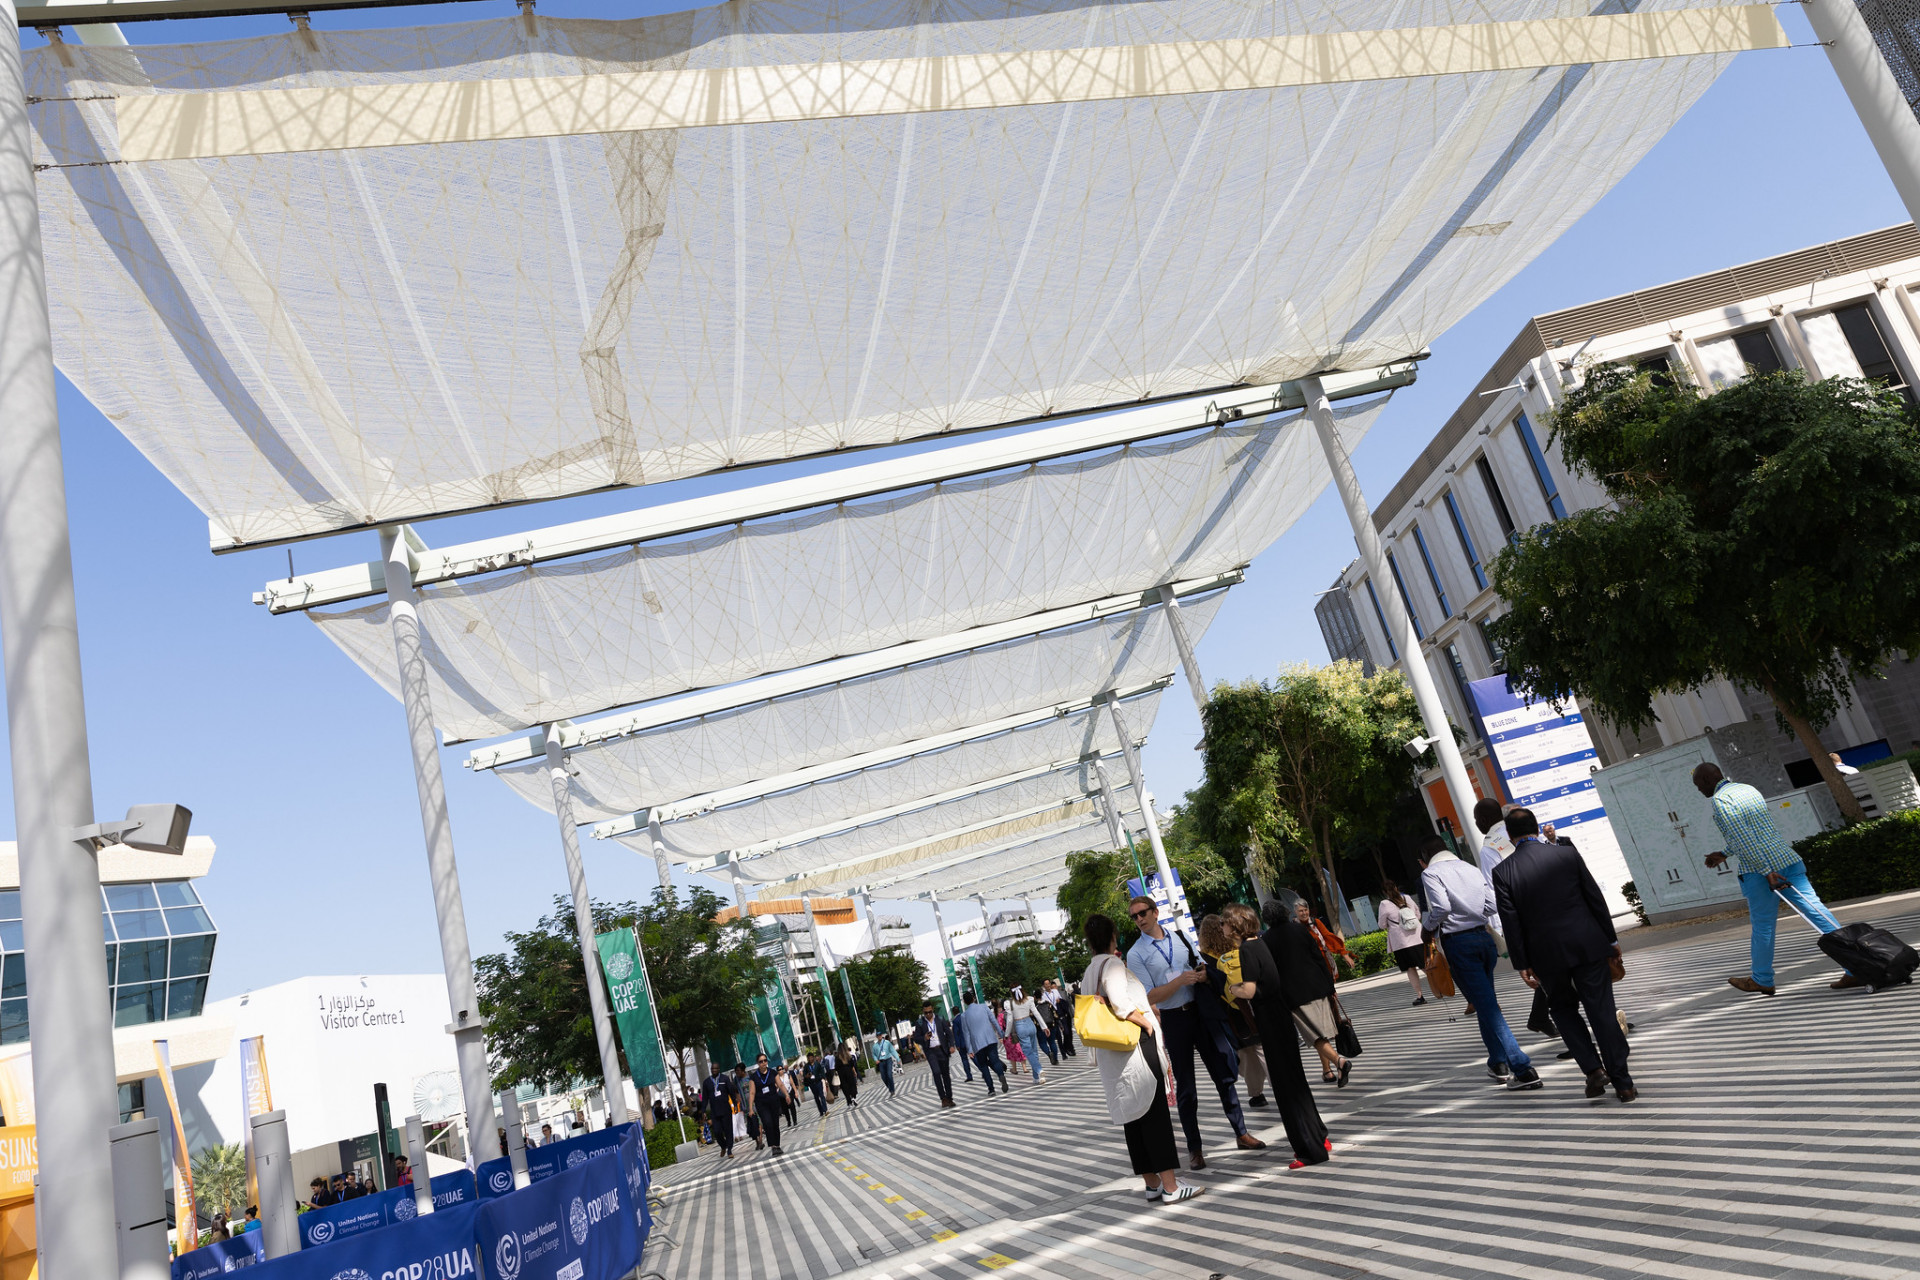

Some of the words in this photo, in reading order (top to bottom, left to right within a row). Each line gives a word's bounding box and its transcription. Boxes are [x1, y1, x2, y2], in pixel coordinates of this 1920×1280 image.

[1491, 719, 1506, 729] BLUE
[1505, 716, 1518, 726] ZONE
[611, 977, 645, 1000] COP28
[318, 994, 326, 1011] 1
[354, 995, 376, 1012] مركز
[614, 995, 638, 1014] UAE
[769, 996, 785, 1008] OP28
[320, 1012, 360, 1031] Visitor
[362, 1010, 398, 1027] Centre
[398, 1009, 405, 1024] 1
[246, 1058, 261, 1118] UNSET
[337, 1216, 357, 1227] United
[357, 1211, 379, 1222] Nations
[338, 1224, 359, 1235] Climate
[359, 1219, 380, 1229] Change
[521, 1227, 539, 1245] United
[538, 1220, 558, 1237] Nations
[524, 1246, 543, 1263] Climate
[541, 1237, 560, 1253] Change
